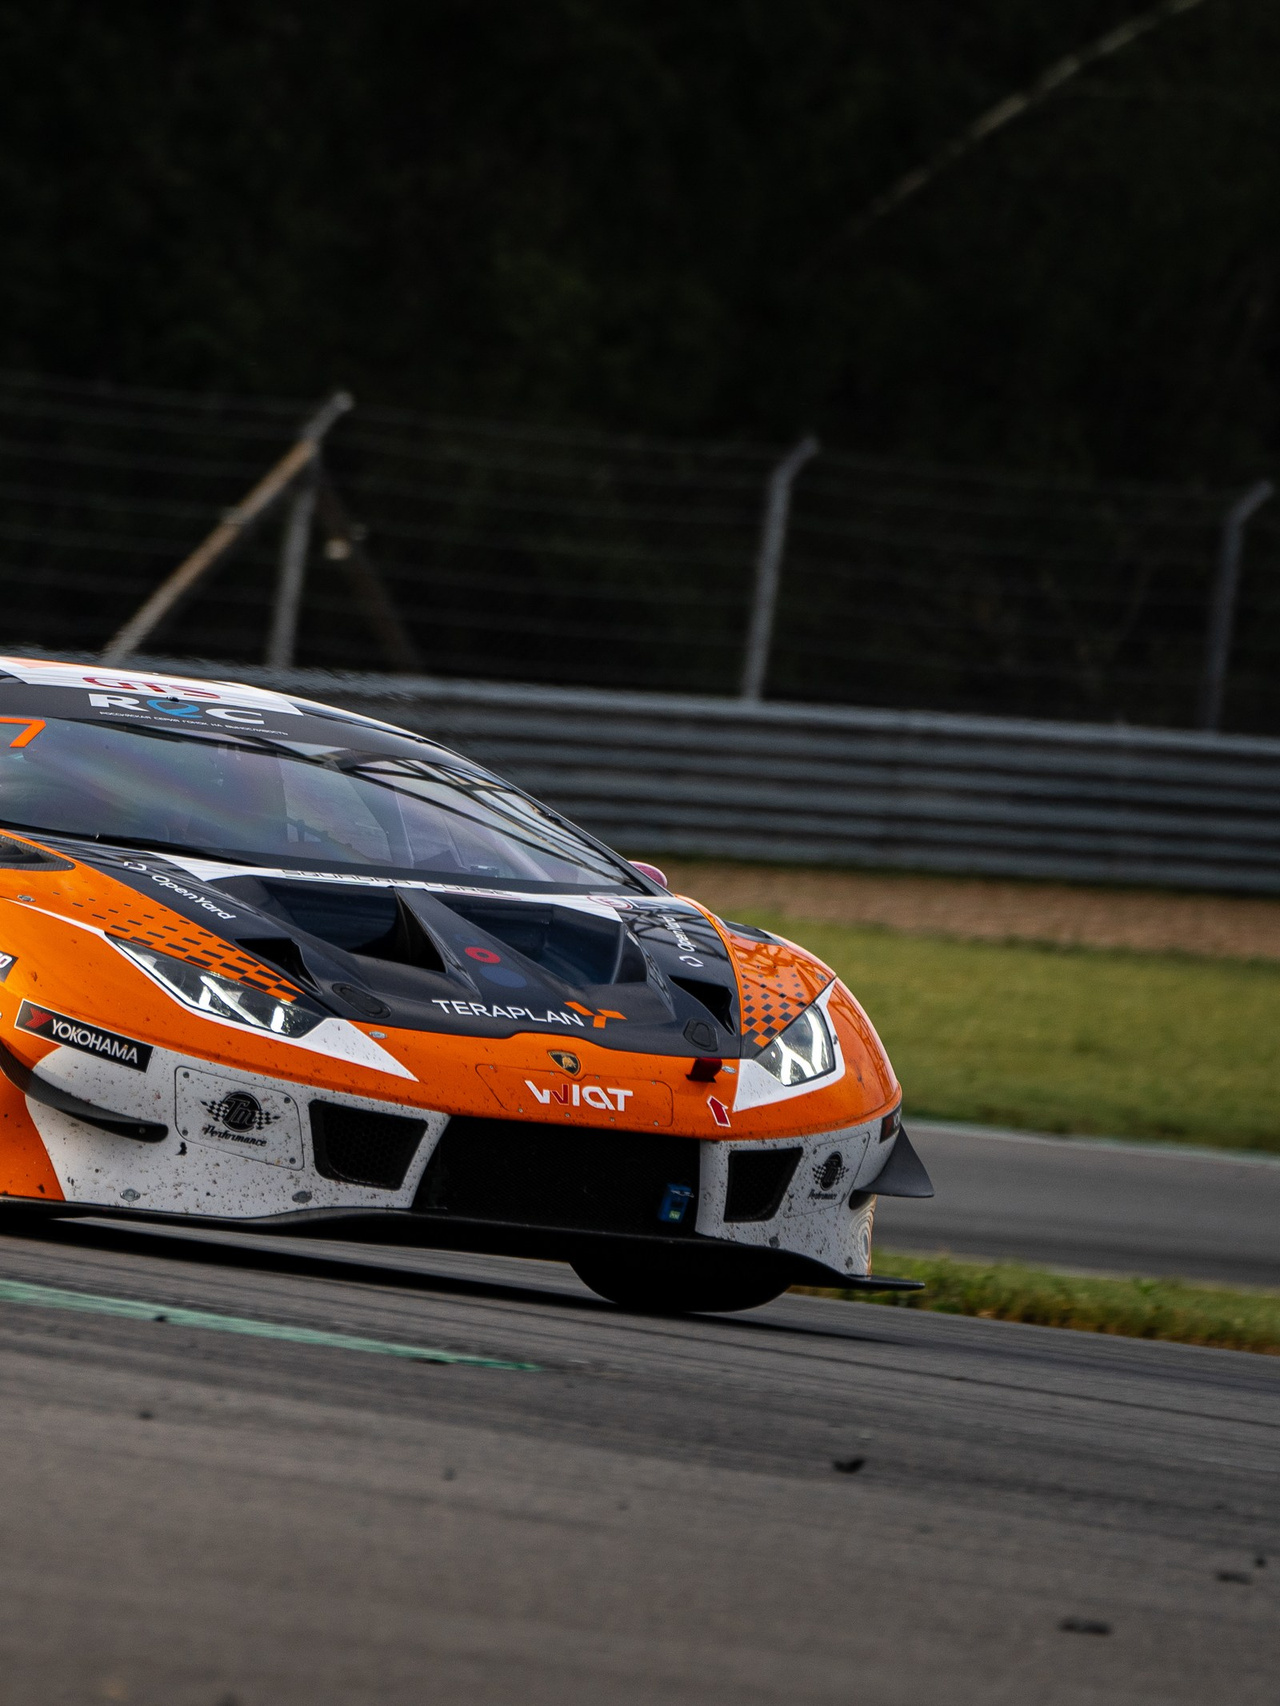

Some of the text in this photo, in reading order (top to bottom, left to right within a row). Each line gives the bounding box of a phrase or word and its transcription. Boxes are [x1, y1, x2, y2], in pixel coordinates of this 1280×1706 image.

[151, 875, 237, 920] OpenYard
[431, 999, 585, 1028] TERAPLAN
[51, 1018, 138, 1064] YOKOHAMA
[201, 1123, 268, 1147] Performance
